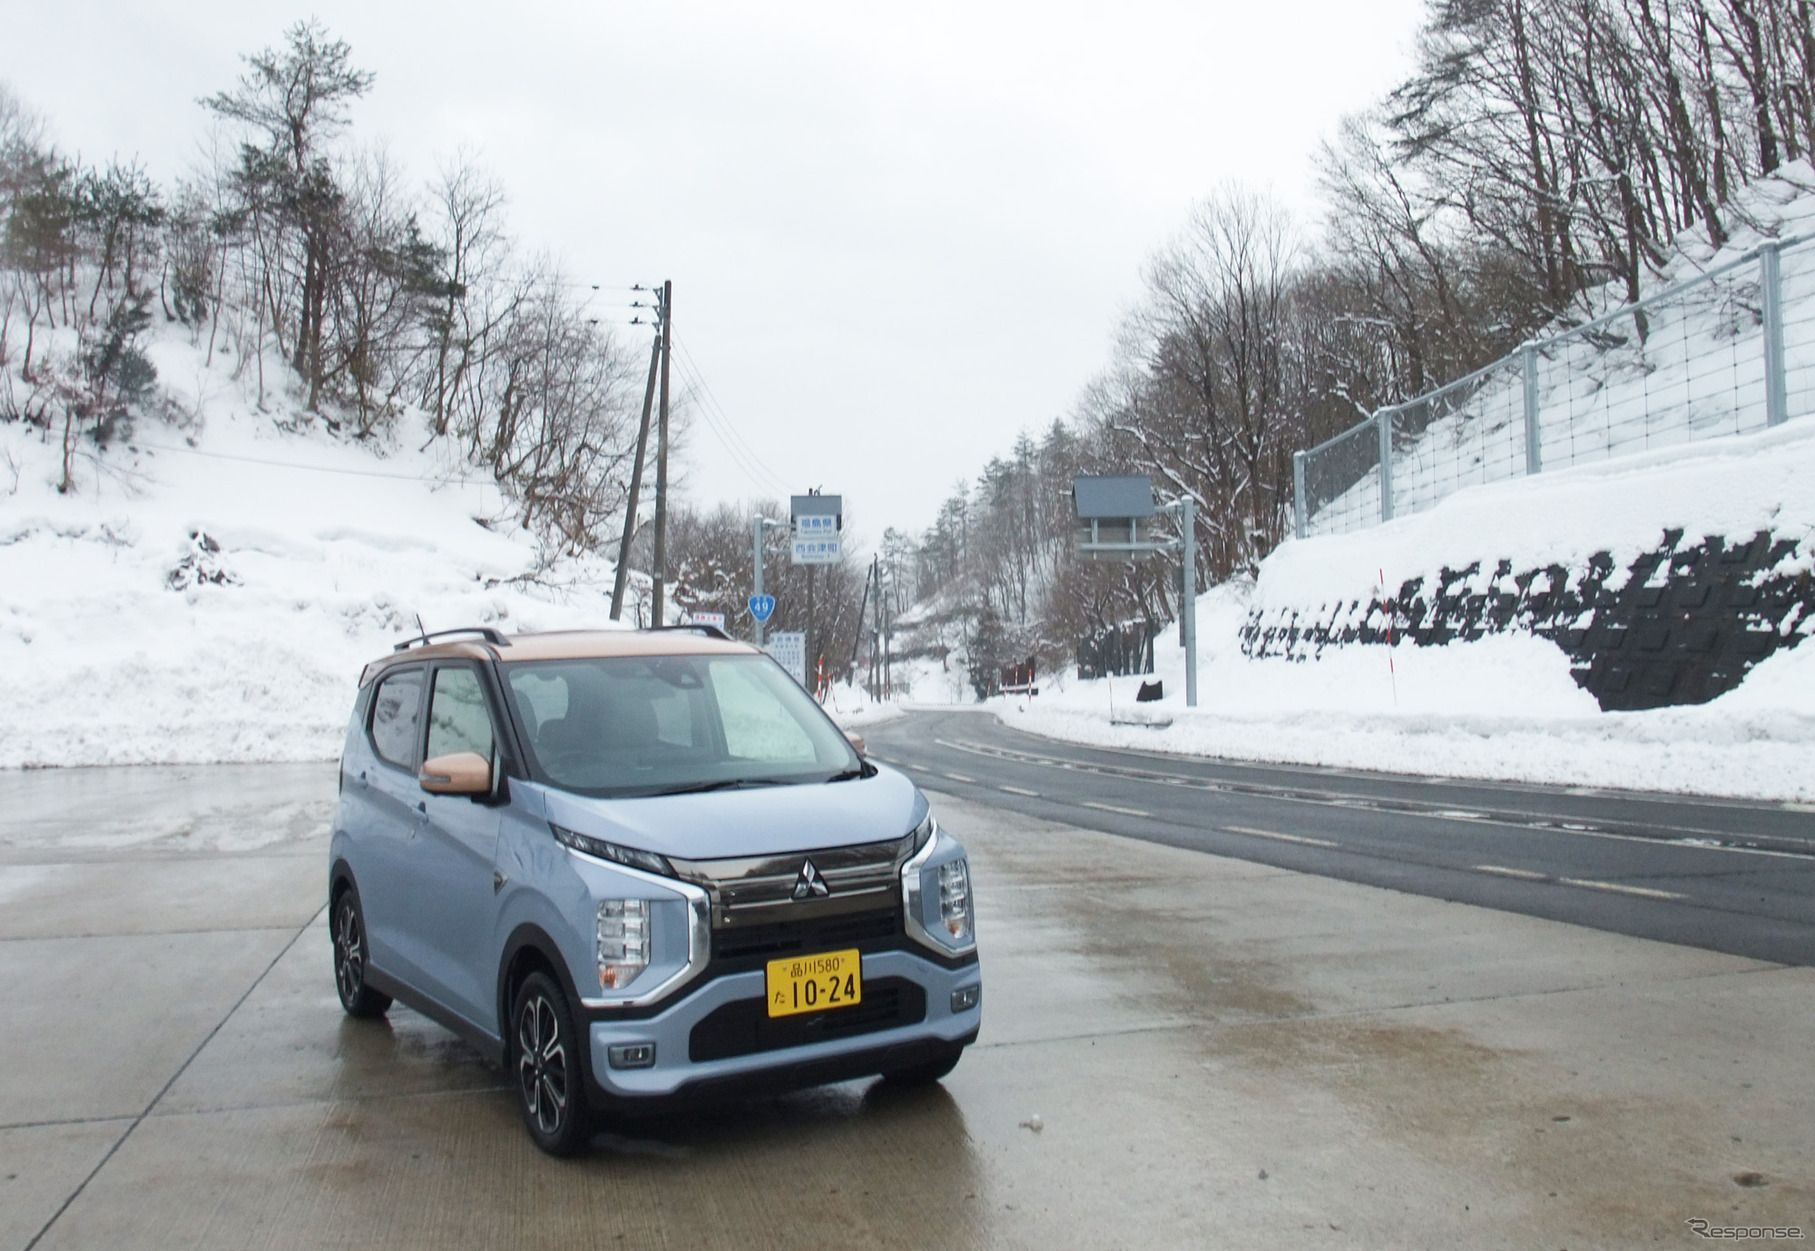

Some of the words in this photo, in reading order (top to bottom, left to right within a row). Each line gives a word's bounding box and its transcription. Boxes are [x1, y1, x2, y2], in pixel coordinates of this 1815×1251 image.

[801, 518, 832, 528] 福島県
[754, 602, 769, 613] 49
[774, 991, 785, 1004] た
[793, 973, 855, 1008] 10-24
